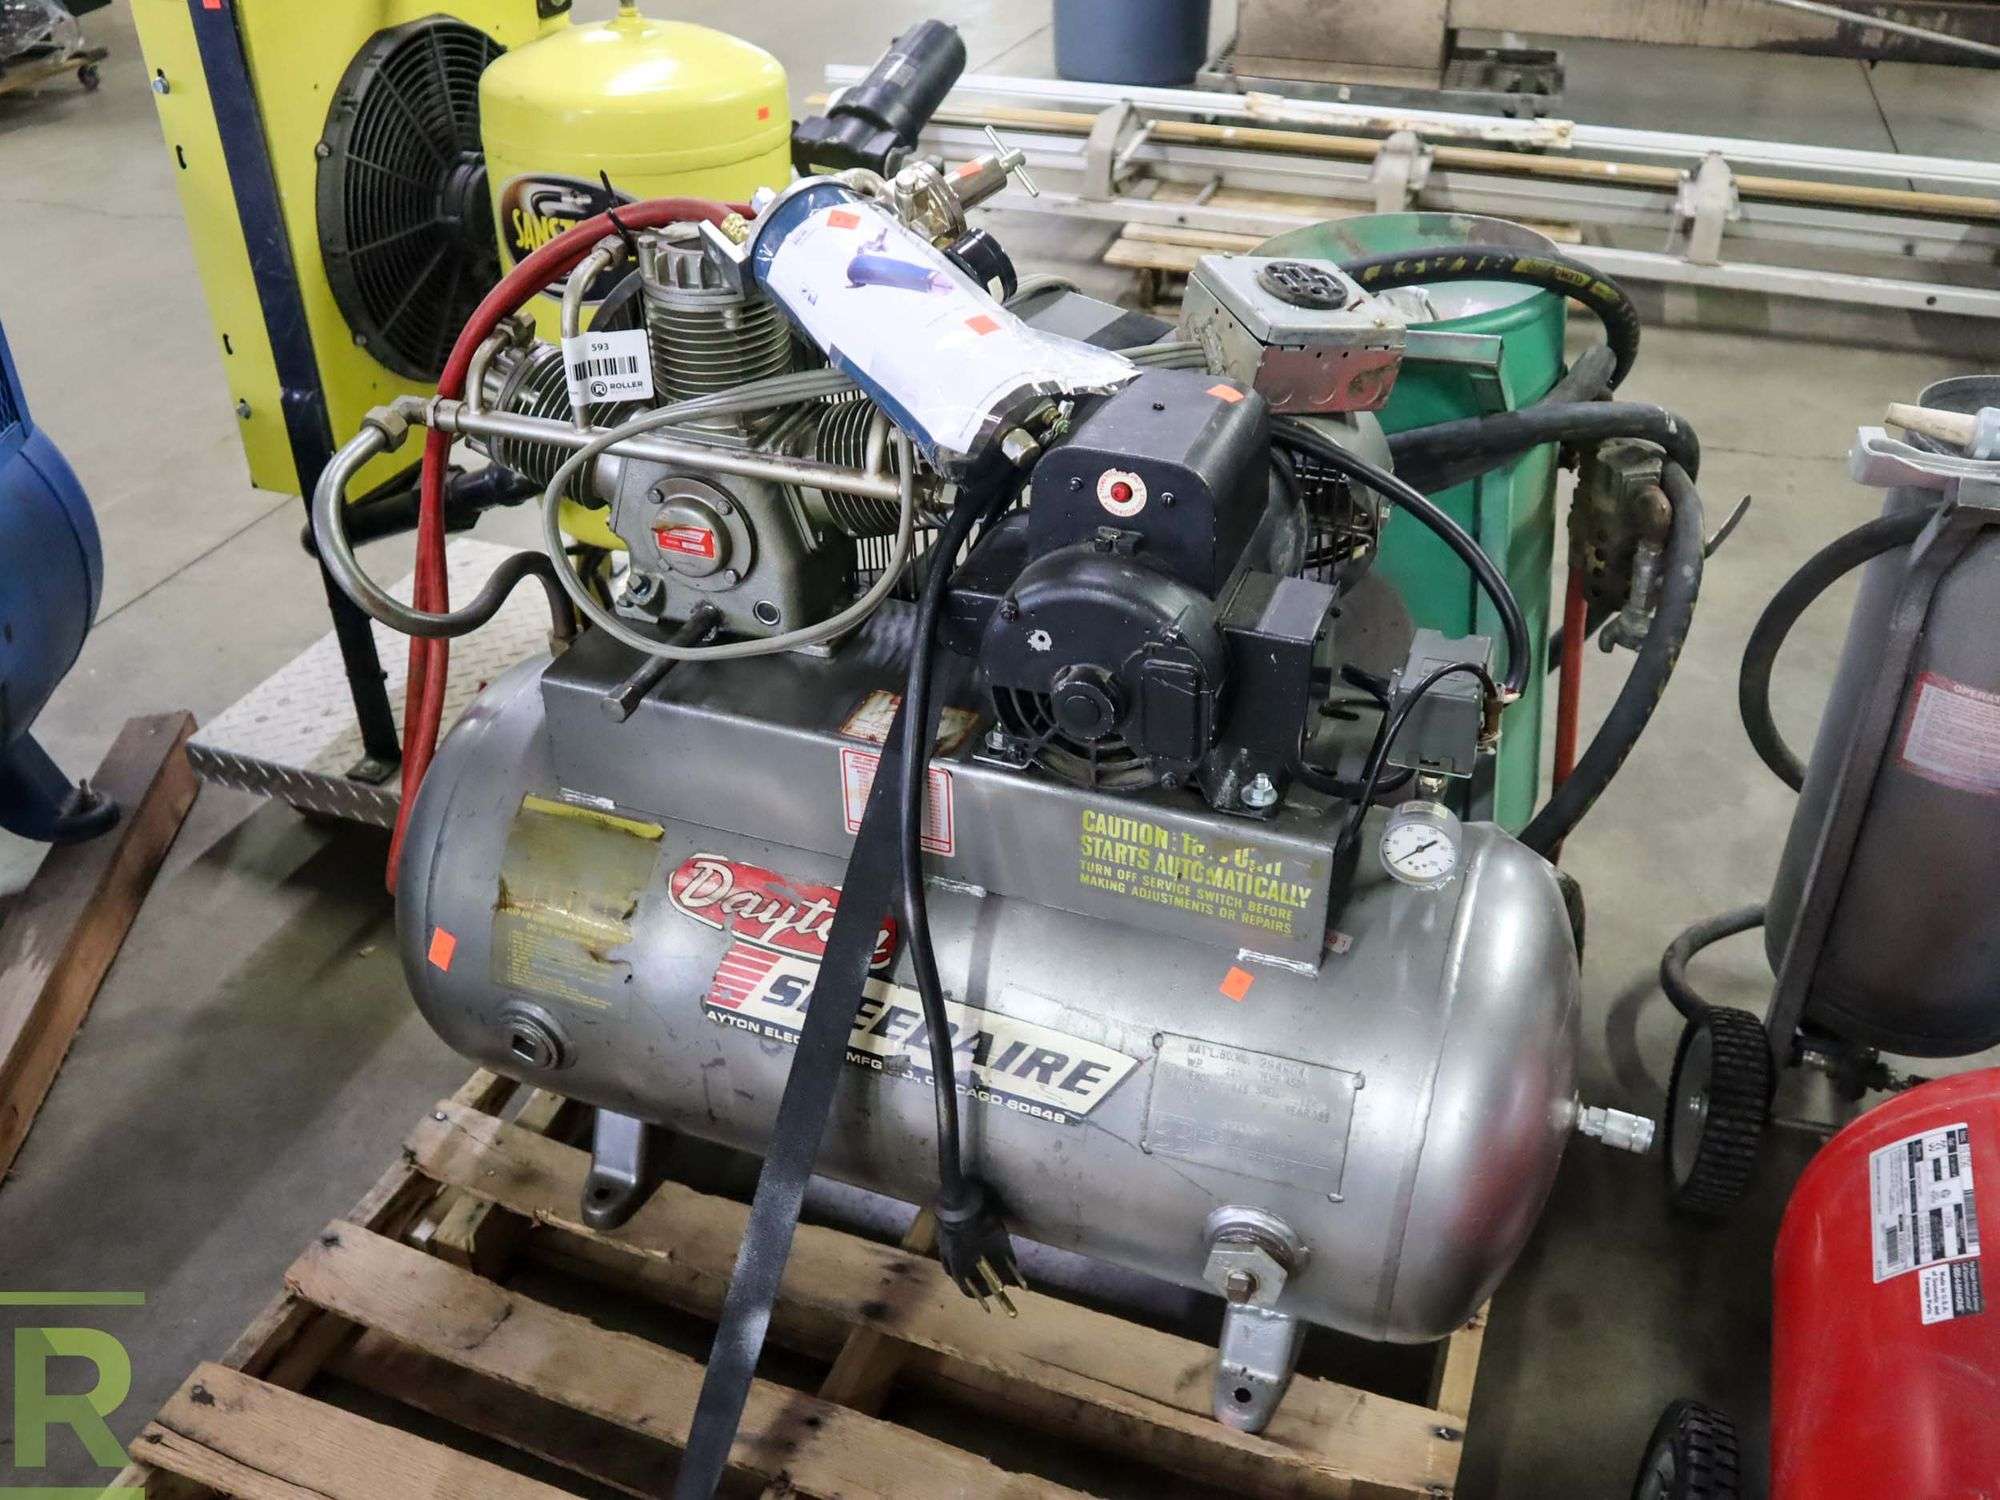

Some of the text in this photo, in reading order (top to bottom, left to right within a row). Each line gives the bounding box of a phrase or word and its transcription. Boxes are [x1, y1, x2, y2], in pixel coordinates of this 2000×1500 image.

[591, 343, 609, 352] 593
[609, 380, 643, 390] ROLLER
[1081, 834, 1151, 871] STARTS
[679, 860, 889, 955] Dayto
[1080, 873, 1292, 935] MAKING ADJUSTMENTS OR REPAIRS
[1081, 860, 1294, 921] TURN OFF SERVICE SWITCH BEFORE
[762, 974, 1111, 1096] SEEDAIRE
